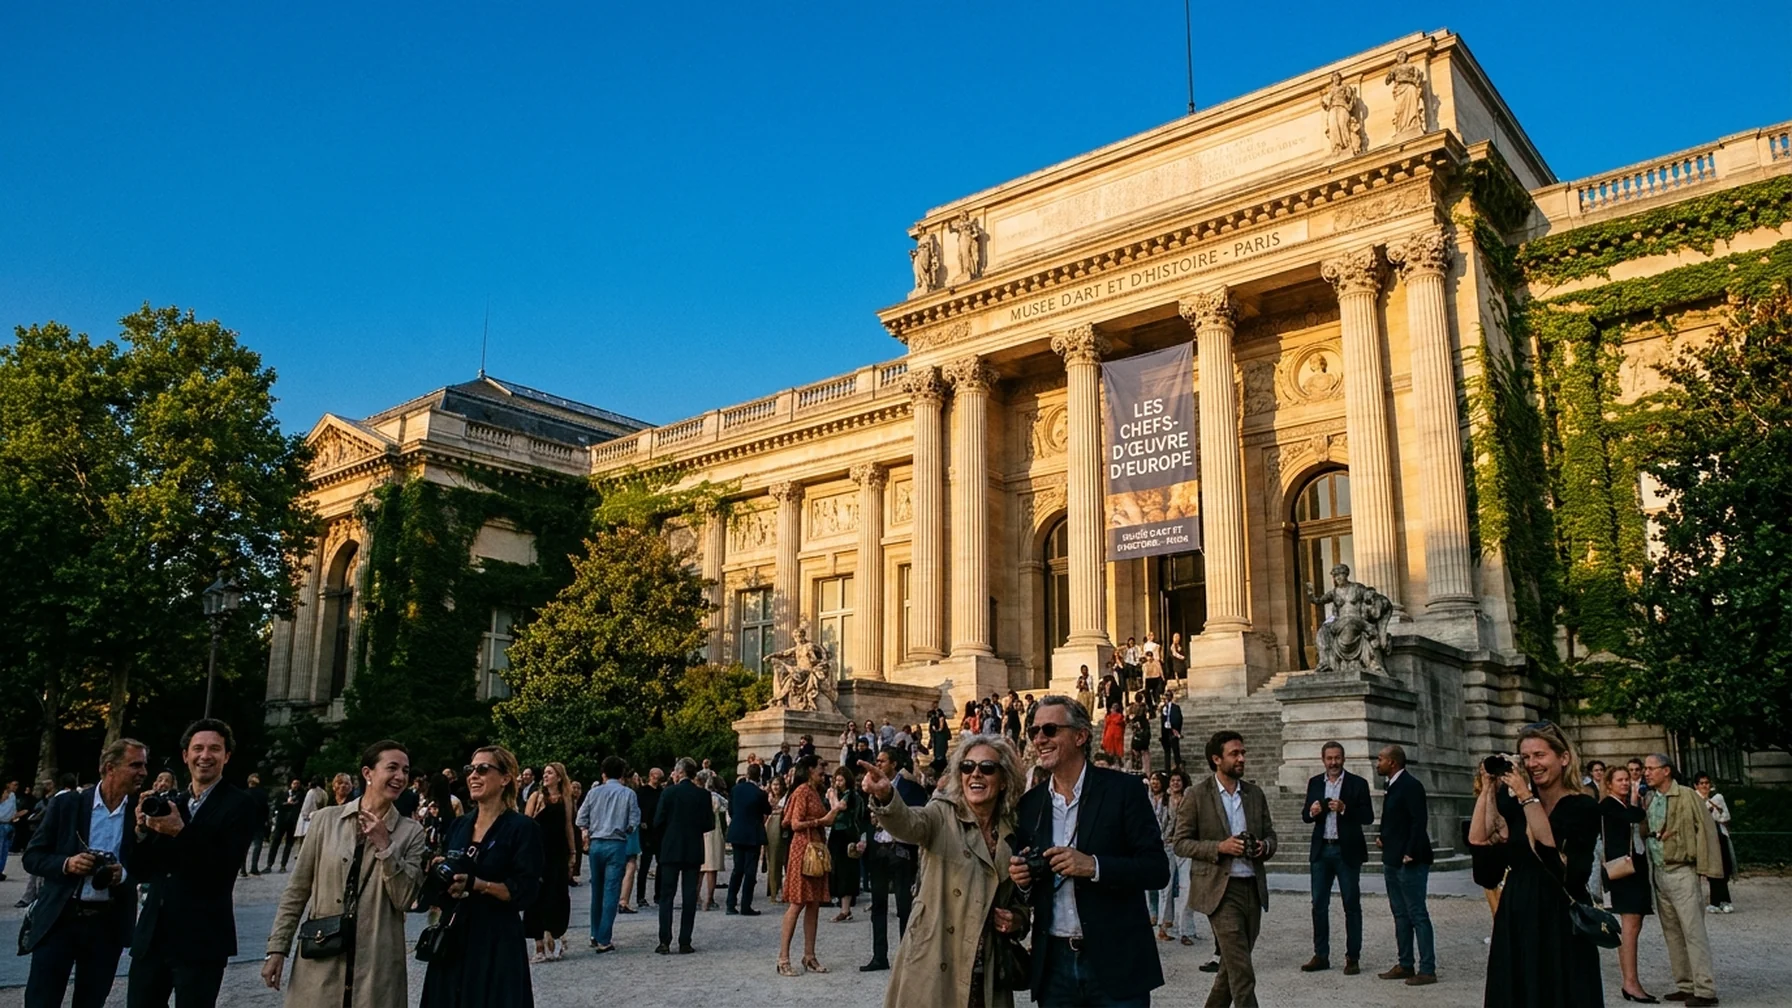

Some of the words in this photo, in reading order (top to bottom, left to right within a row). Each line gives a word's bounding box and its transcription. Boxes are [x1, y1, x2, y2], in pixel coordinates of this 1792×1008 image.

[1010, 297, 1056, 322] MUSEE
[1062, 284, 1102, 307] D'ART
[1107, 276, 1126, 295] ET
[1131, 250, 1218, 287] D'HISTOIRE
[1234, 231, 1281, 257] PARIS
[1134, 398, 1163, 418] LES
[1120, 415, 1179, 439] CHEFS-
[1112, 431, 1188, 460] D'ŒUVRE
[1110, 450, 1192, 479] D'EUROPE
